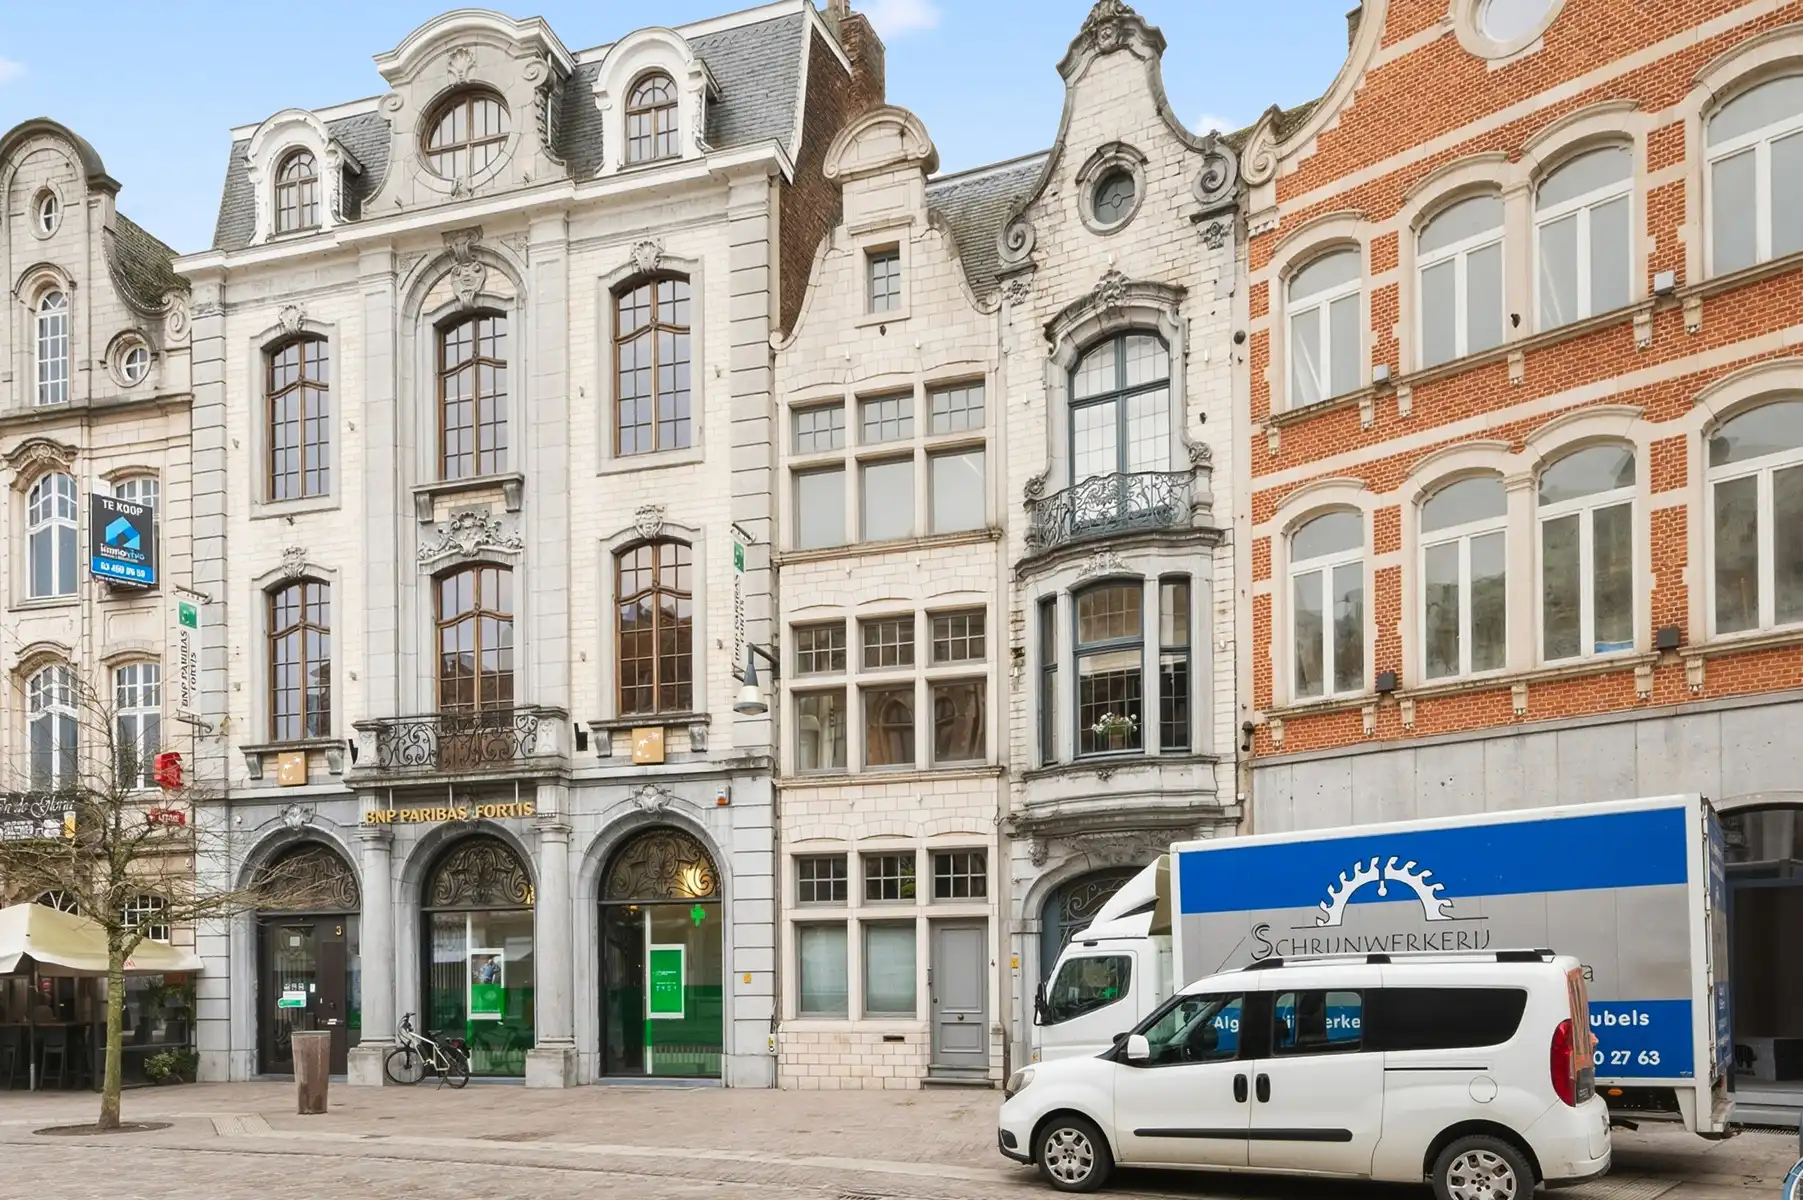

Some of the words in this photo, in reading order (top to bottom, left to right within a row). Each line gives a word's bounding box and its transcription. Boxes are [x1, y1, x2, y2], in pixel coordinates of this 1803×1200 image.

[102, 499, 115, 511] TE
[116, 501, 143, 516] KOOP
[180, 630, 188, 680] PARIBAS
[181, 682, 189, 707] BNP
[365, 809, 396, 824] BNP
[400, 806, 469, 823] PARIBAS
[474, 801, 537, 819] FORTIS
[336, 925, 343, 936] 3
[1589, 1010, 1650, 1026] ubels
[1592, 1050, 1605, 1065] 0
[1610, 1050, 1631, 1065] 27
[1637, 1050, 1661, 1065] 63
